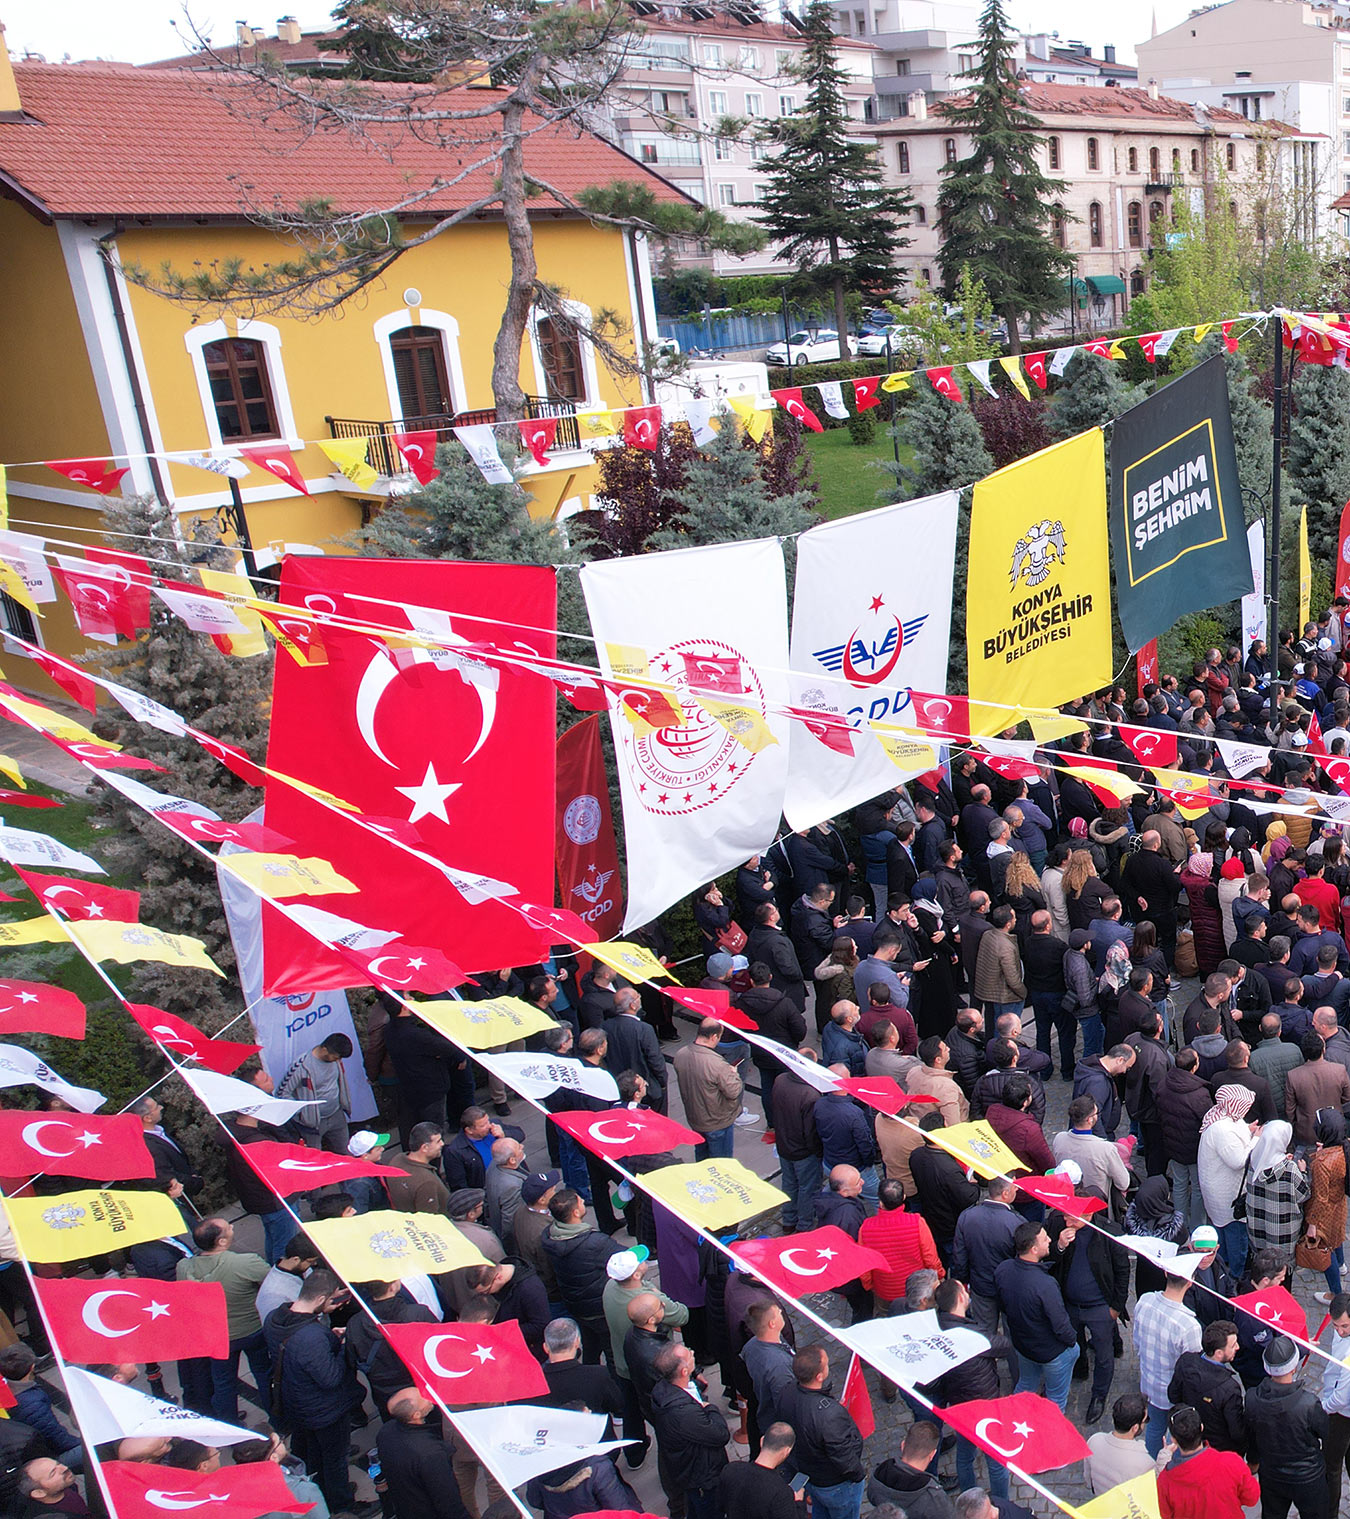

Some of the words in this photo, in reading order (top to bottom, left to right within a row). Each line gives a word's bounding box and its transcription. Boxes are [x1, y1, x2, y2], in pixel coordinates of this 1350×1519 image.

[1012, 583, 1063, 621] KONYA
[983, 594, 1093, 660] BÜYÜKŞEHİR
[1005, 623, 1071, 664] BELEDİYESİ
[580, 899, 613, 922] TCDD
[89, 1200, 106, 1222] KONYA
